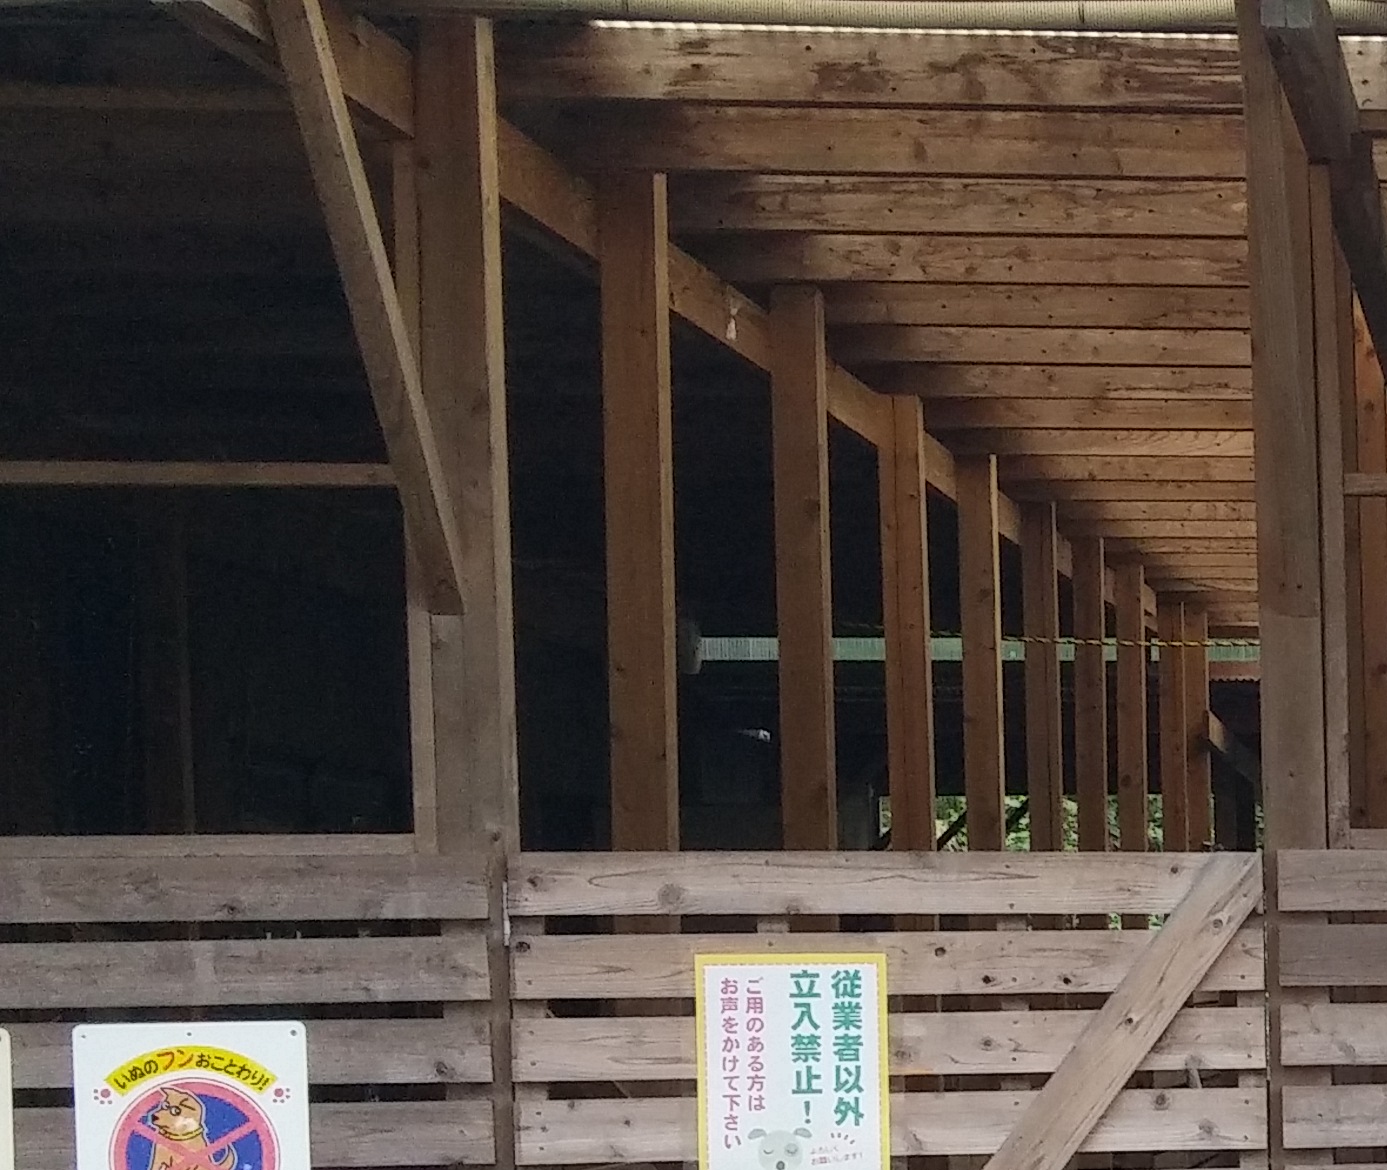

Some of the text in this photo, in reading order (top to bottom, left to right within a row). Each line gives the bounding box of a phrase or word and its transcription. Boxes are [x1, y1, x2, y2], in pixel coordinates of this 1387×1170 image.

[719, 977, 742, 1150] お声をかけて下さい
[745, 976, 766, 1112] ご用のある方は
[831, 969, 865, 1127] 従業者以外
